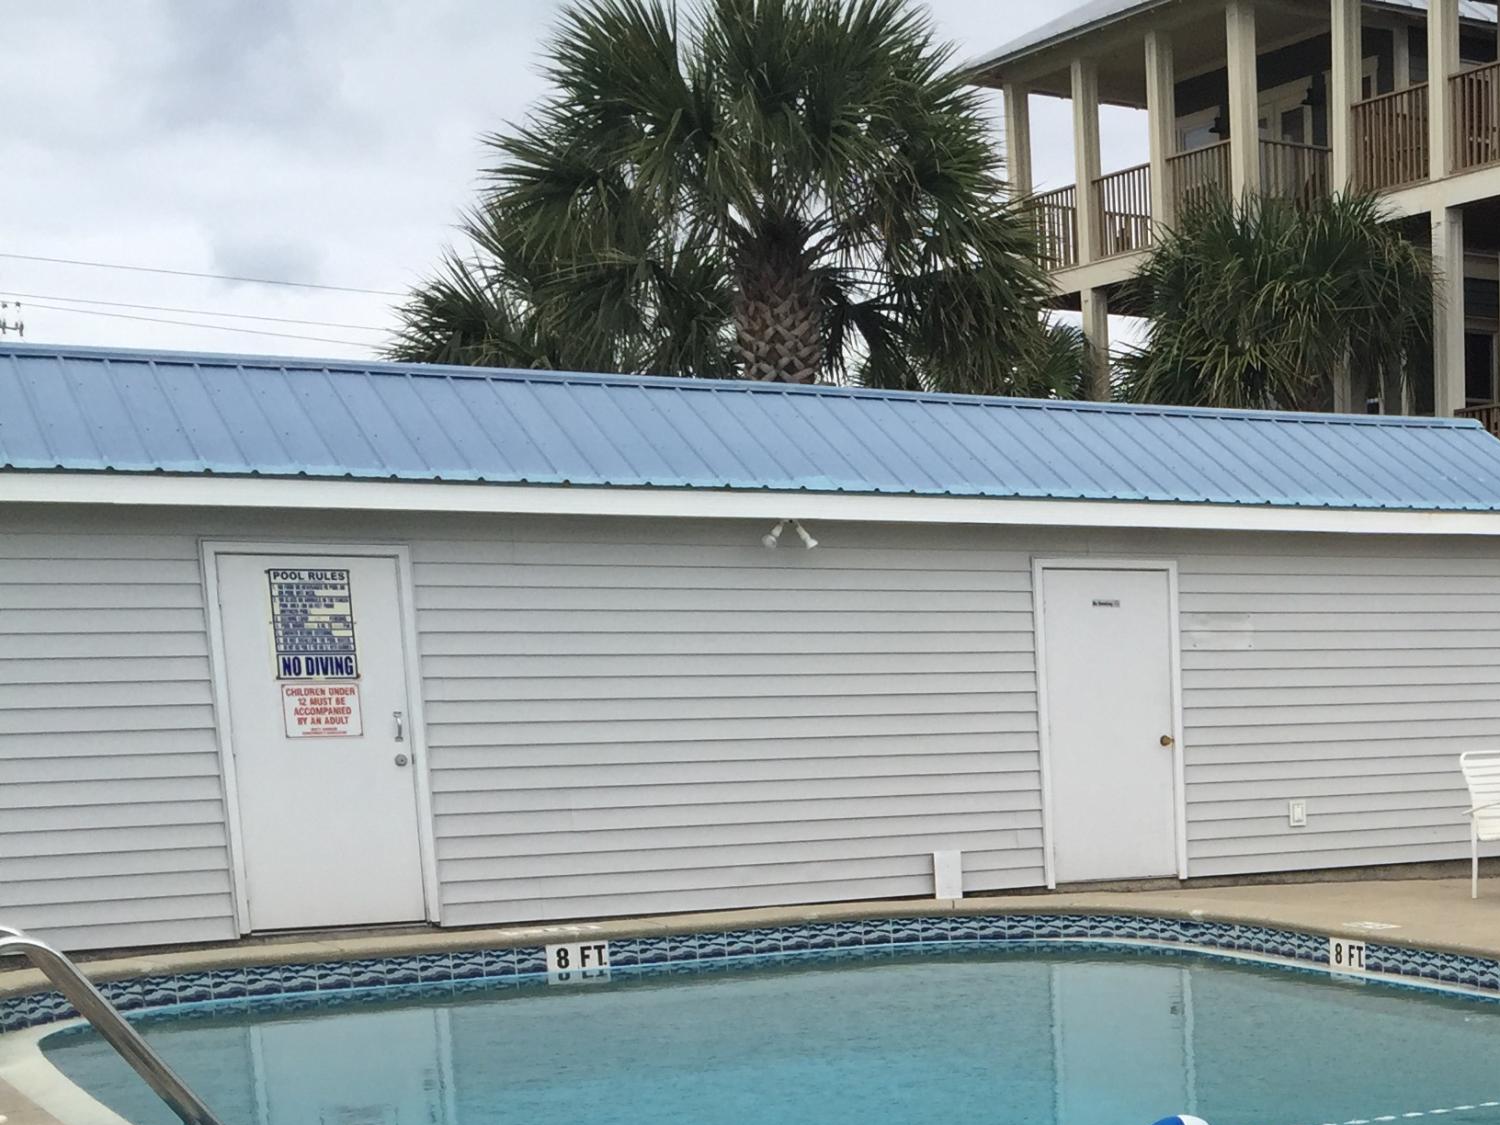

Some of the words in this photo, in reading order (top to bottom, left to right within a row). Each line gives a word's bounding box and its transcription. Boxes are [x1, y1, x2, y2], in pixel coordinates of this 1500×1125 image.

[273, 571, 305, 580] POOL
[308, 571, 345, 580] RULES
[282, 656, 302, 676] NO
[305, 656, 354, 676] DIVING
[285, 687, 326, 696] CHILDREN
[328, 687, 356, 696] UNDER
[298, 697, 307, 706] 12
[310, 697, 332, 706] MUST
[336, 697, 346, 706] BE
[294, 707, 352, 716] ACCOMPANIED
[297, 717, 308, 726] BY
[310, 717, 322, 725] AN
[324, 716, 349, 725] ADULT
[556, 947, 570, 969] 8
[580, 944, 607, 967] FT.
[1335, 943, 1343, 964] 8
